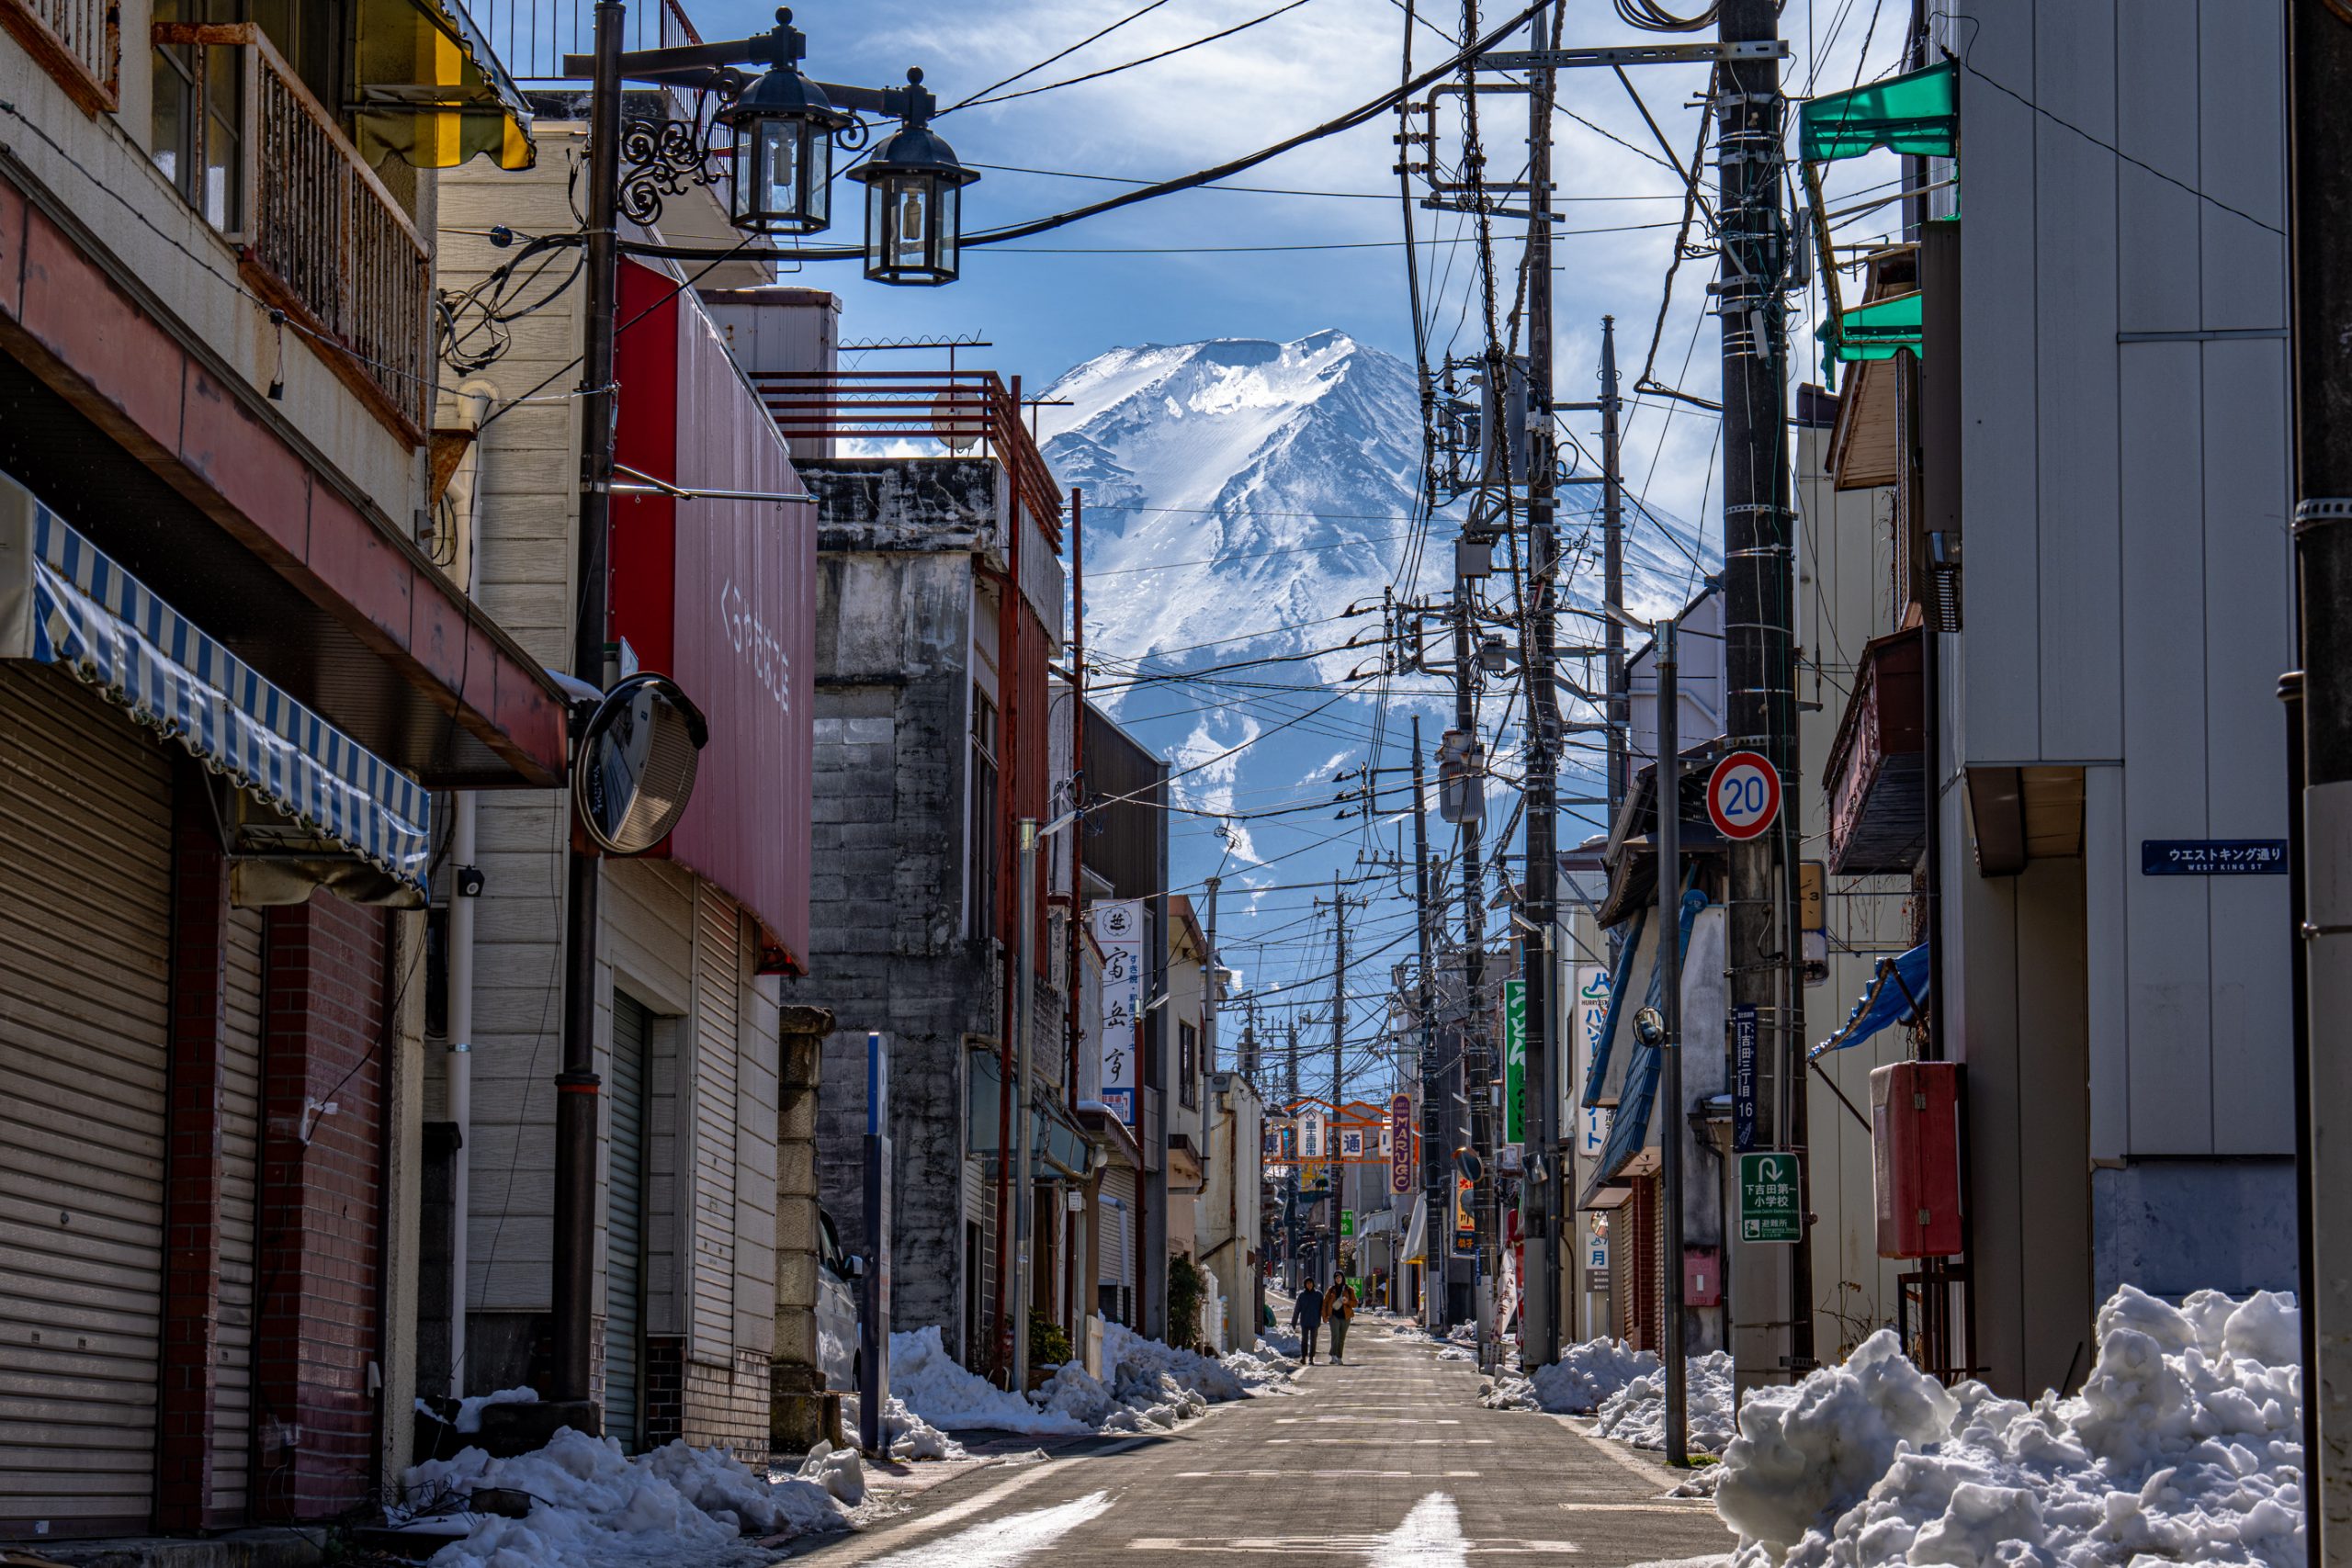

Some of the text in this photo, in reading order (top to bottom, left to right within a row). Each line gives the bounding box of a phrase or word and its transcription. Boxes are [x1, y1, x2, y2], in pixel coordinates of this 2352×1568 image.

[1724, 776, 1764, 816] 20
[2169, 848, 2280, 861] ウエストキング通り
[1741, 1021, 1751, 1098] 下吉田三丁目
[1738, 1102, 1753, 1118] 16
[1746, 1183, 1797, 1196] 下吉田第一
[1754, 1195, 1789, 1207] 小学校
[1761, 1219, 1788, 1228] 避難所
[1591, 1250, 1605, 1266] 月
